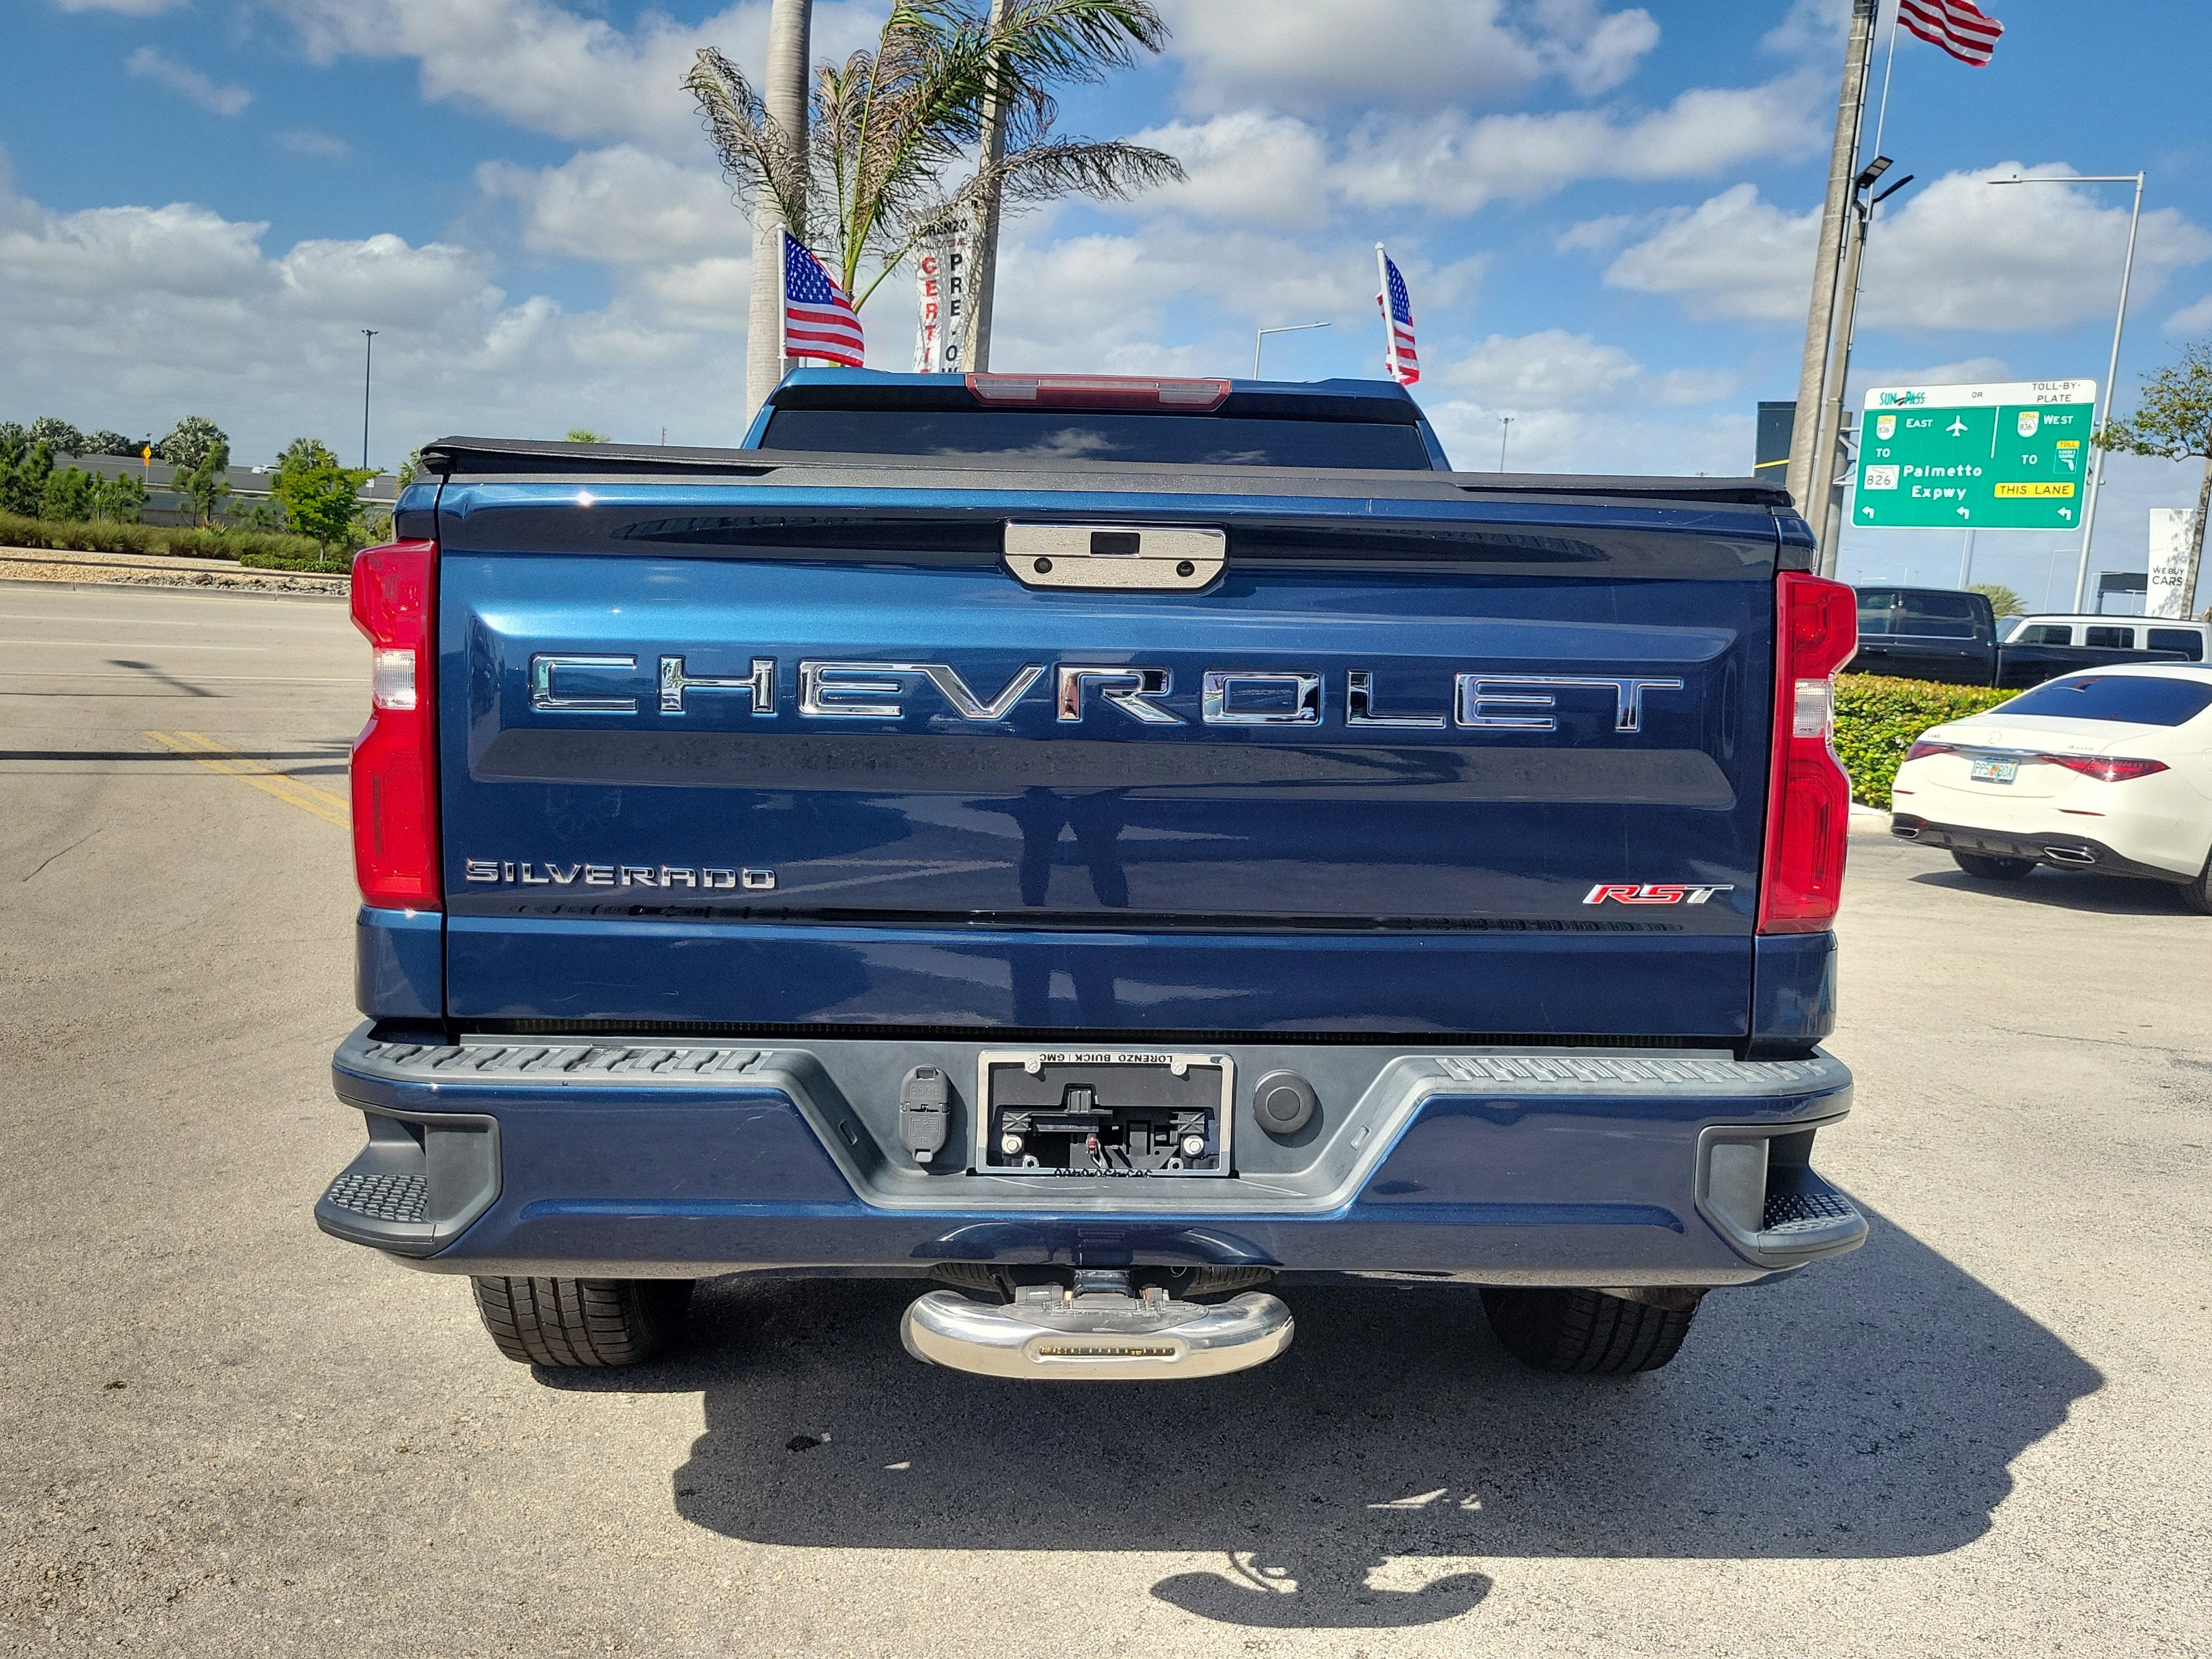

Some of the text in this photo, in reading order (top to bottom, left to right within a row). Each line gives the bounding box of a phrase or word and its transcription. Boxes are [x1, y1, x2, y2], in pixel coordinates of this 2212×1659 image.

[920, 256, 938, 373] CERTI
[2032, 382, 2081, 391] TOLL-BY-
[2036, 394, 2072, 403] PLATE
[1905, 418, 1933, 428] EAST
[2044, 415, 2074, 425] WEST
[1876, 448, 1891, 458] TO
[2021, 454, 2038, 465] TO
[1903, 464, 1982, 477] Palmetto
[1866, 475, 1891, 485] 826
[1911, 485, 1967, 501] Expwy
[2000, 486, 2070, 494] THIS LANE
[2152, 576, 2183, 586] CARS
[530, 653, 1683, 732] CHEVROLET
[466, 858, 775, 889] SILVERADO
[1582, 884, 1735, 904] RST
[1039, 1053, 1173, 1063] LORENZO BUICK GMC
